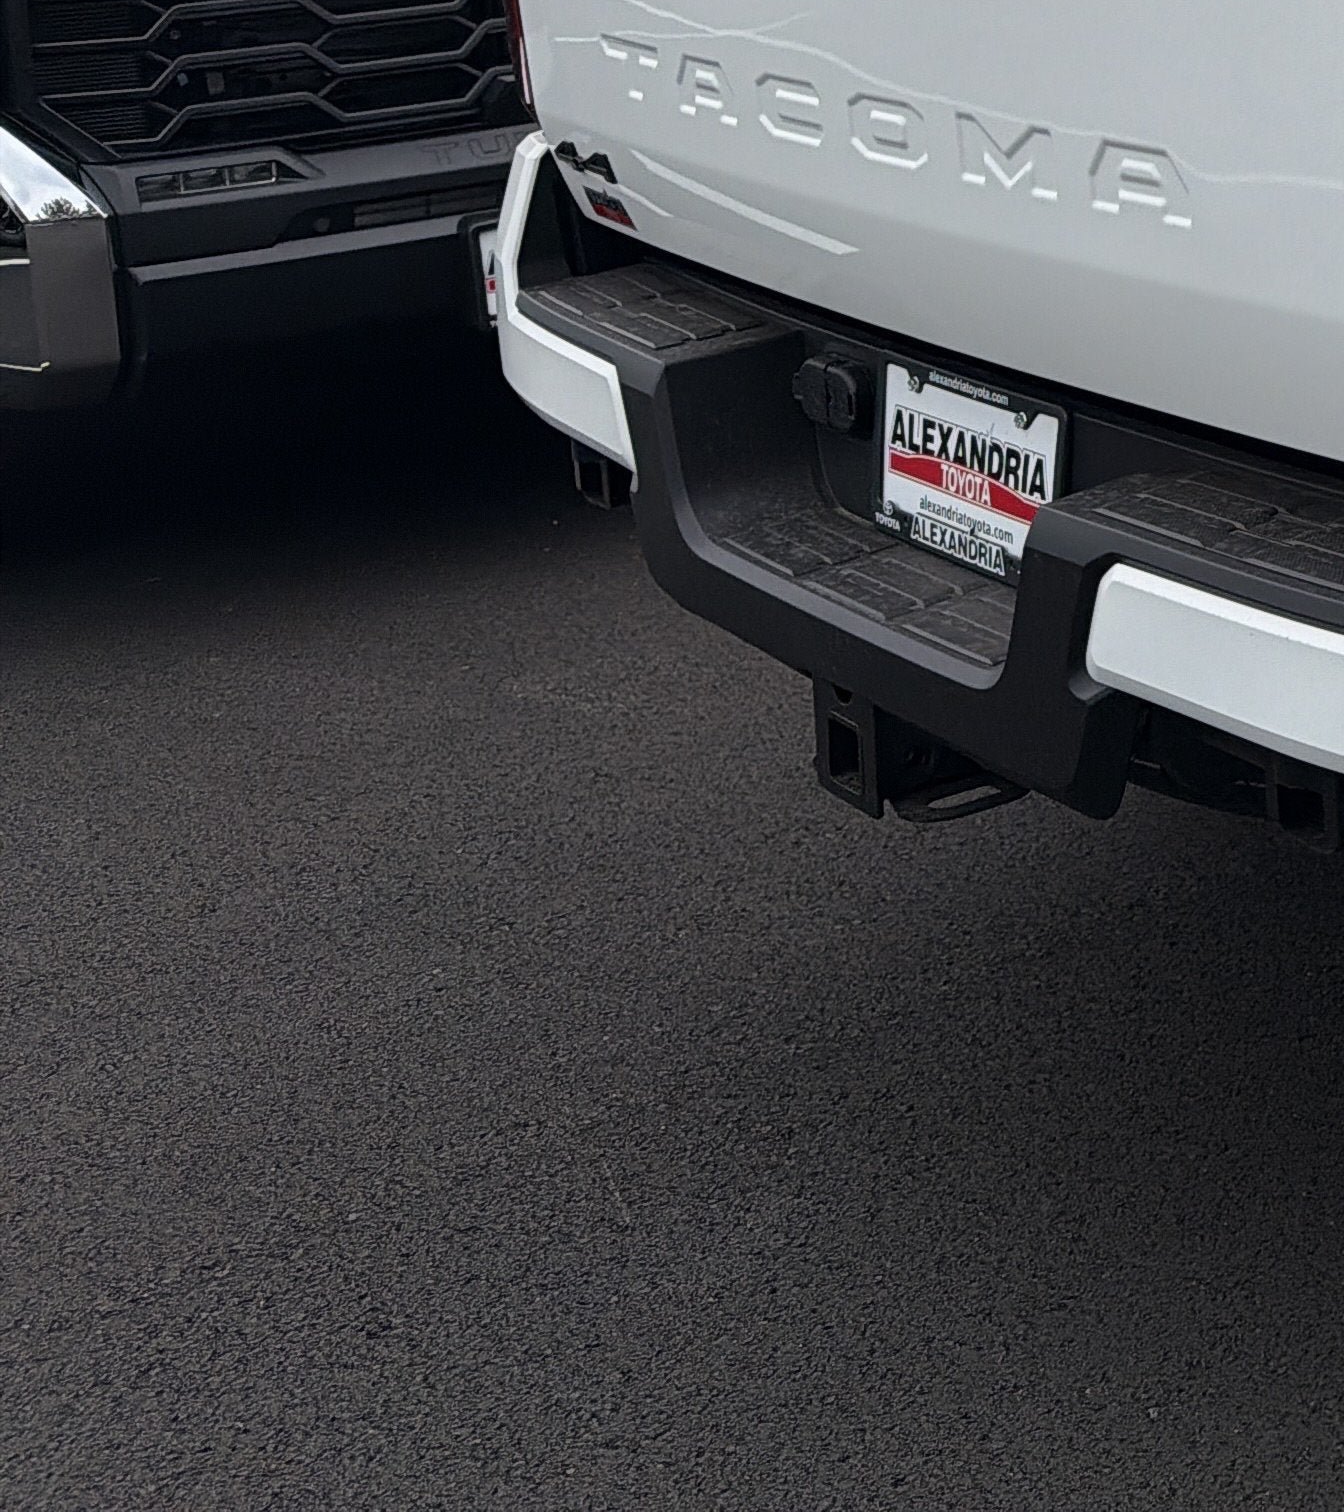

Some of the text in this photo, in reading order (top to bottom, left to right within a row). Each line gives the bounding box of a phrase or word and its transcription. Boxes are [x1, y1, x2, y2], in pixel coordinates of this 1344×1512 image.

[600, 33, 1191, 228] TACOMA
[929, 370, 1009, 407] alexandriatoyota.com
[890, 407, 1047, 502] ALEXANDRIA
[940, 463, 992, 506] TOYOTA
[874, 511, 901, 532] TOYOTA
[919, 494, 1014, 545] alexandriatoyota.com
[911, 516, 1005, 575] ALEXANDRIA
